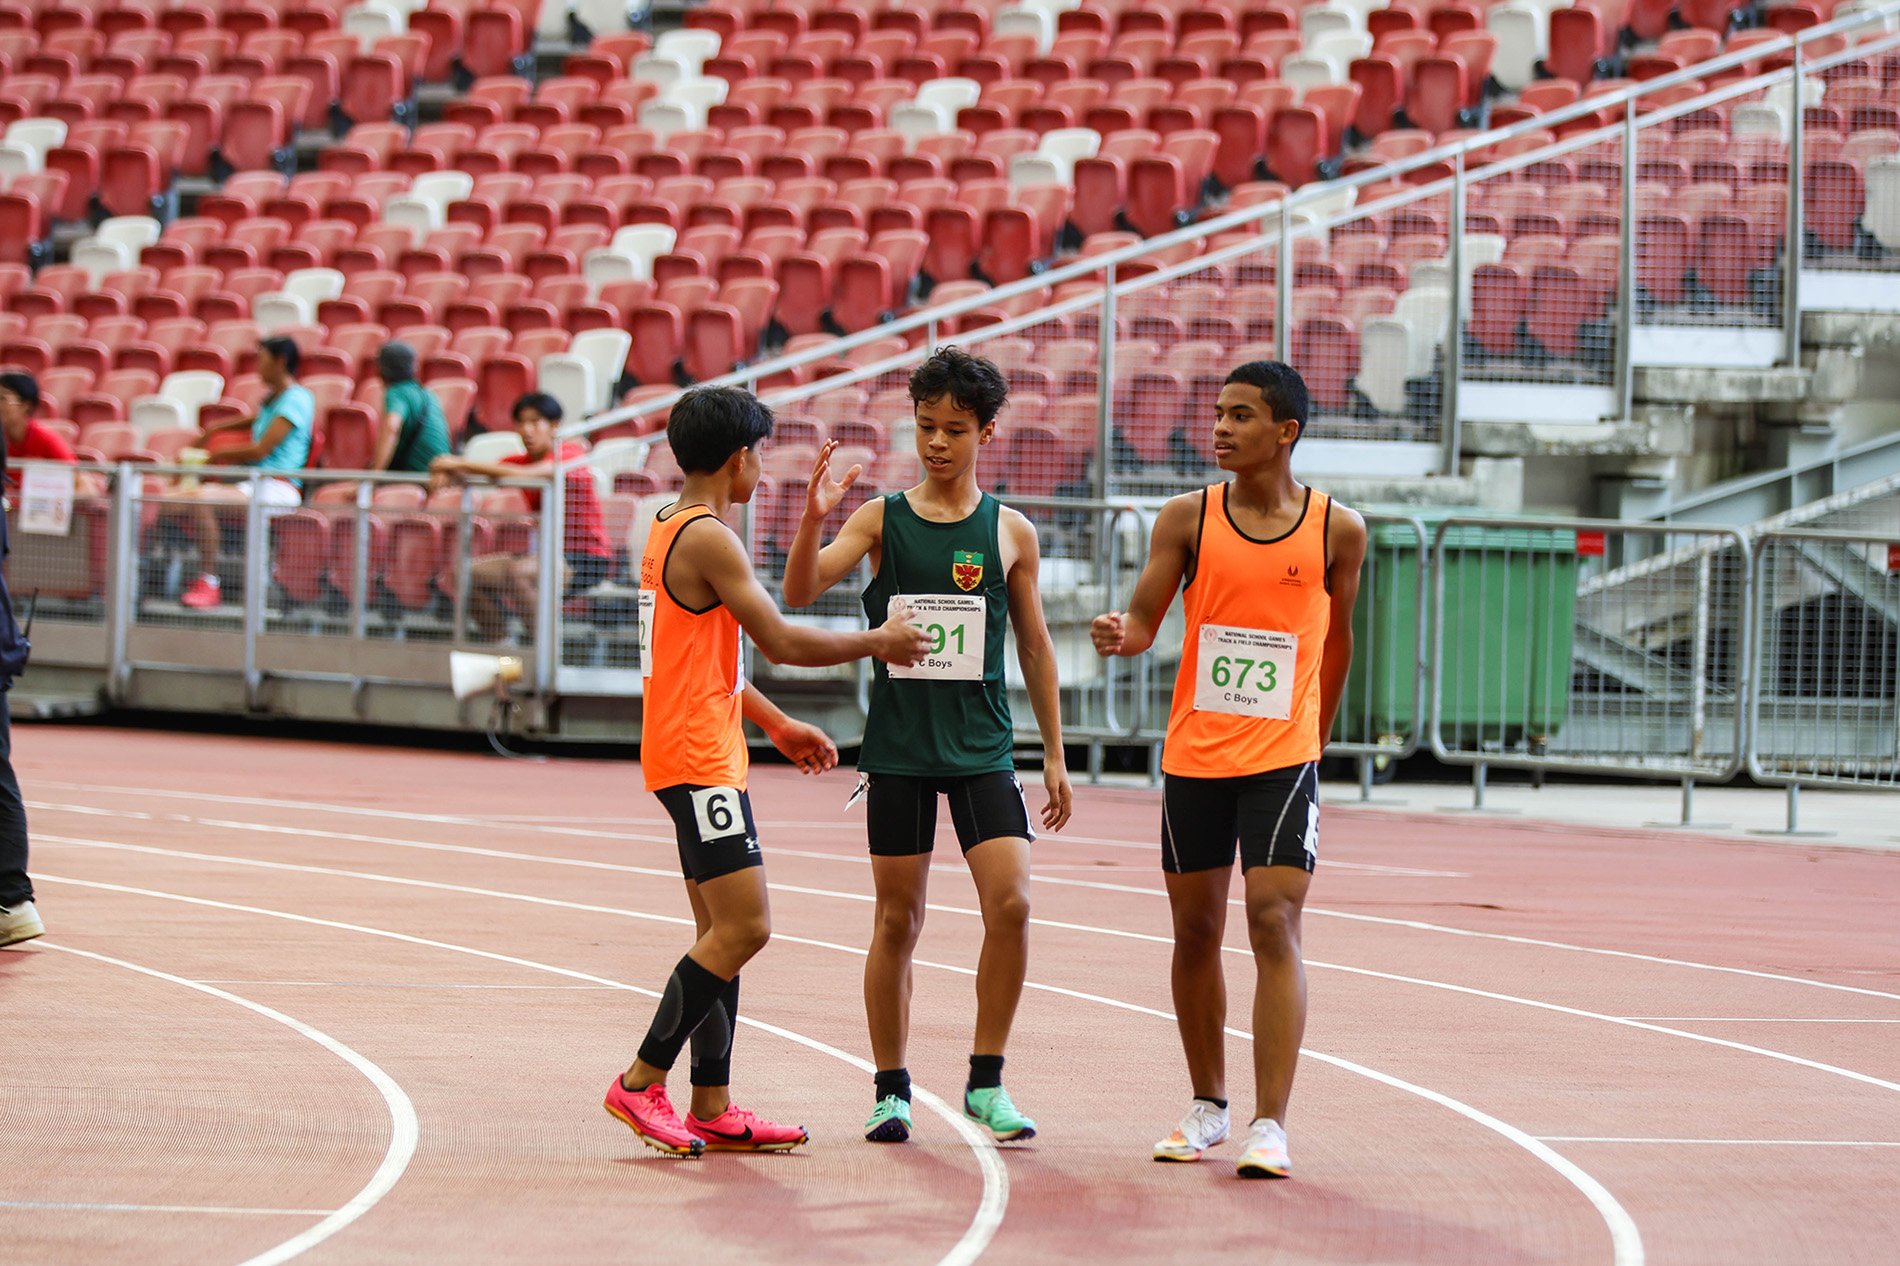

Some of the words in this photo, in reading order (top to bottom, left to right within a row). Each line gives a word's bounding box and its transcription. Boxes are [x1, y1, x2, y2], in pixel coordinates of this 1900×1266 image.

[907, 623, 965, 655] 91
[1224, 631, 1247, 639] NATIONAL
[1248, 633, 1267, 641] SCHOOL
[1268, 635, 1286, 643] GAMES
[1252, 641, 1293, 650] CHAMPIONSHIPS
[928, 659, 953, 670] Boys
[1211, 655, 1277, 692] 673
[1224, 692, 1231, 701] C
[1234, 693, 1258, 705] Boys
[706, 793, 733, 831] 6
